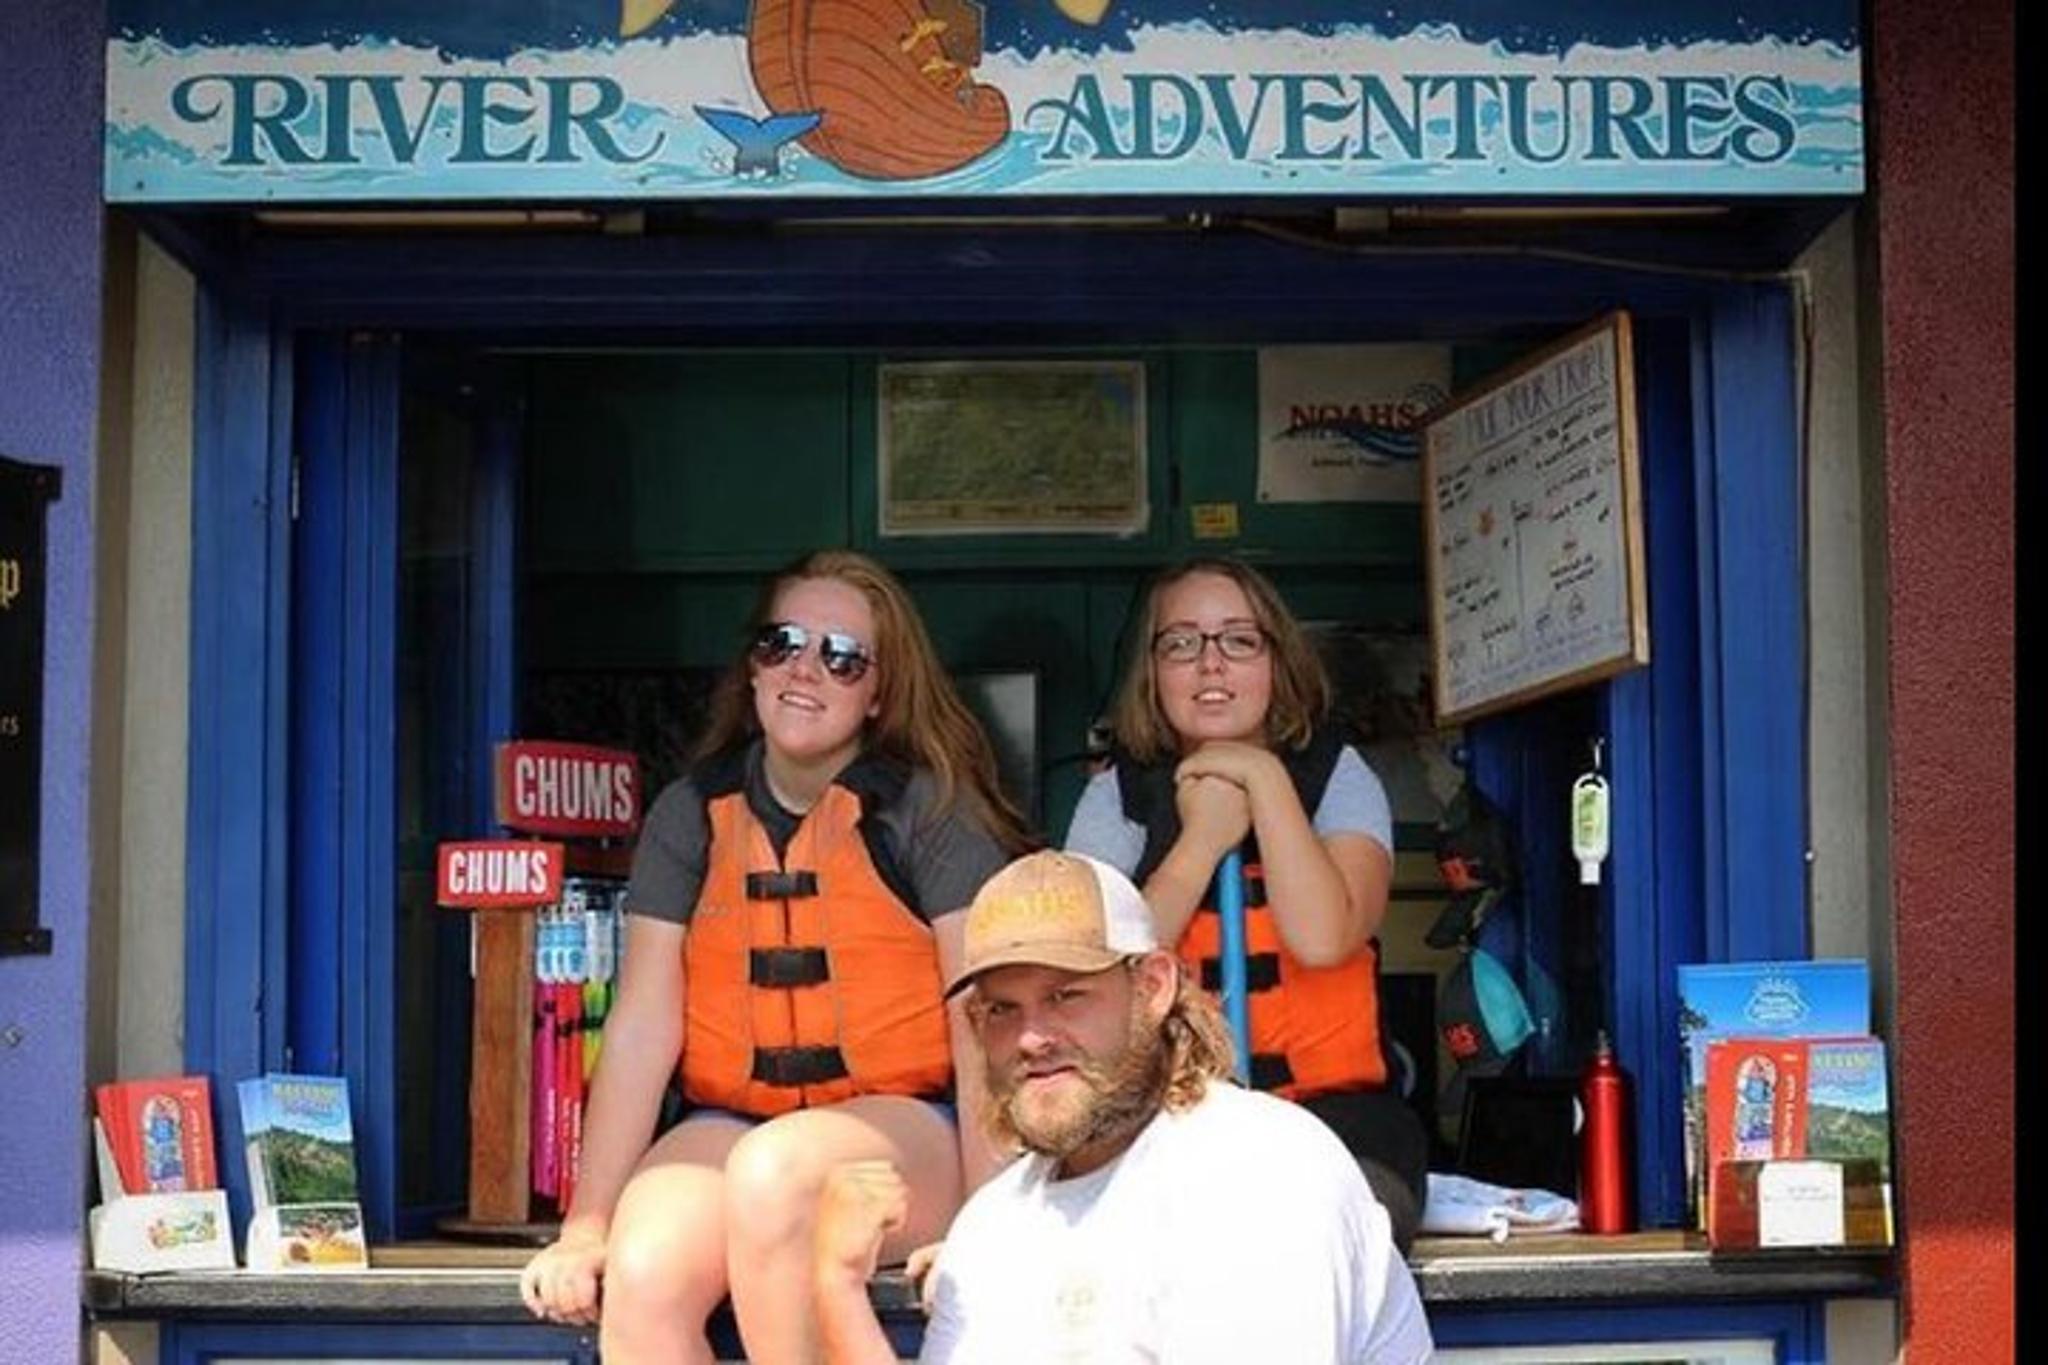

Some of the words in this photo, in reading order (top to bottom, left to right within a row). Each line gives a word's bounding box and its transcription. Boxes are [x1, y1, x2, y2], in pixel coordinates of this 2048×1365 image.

[172, 73, 667, 167] RIVER
[1025, 72, 1798, 164] ADVENTURES
[1288, 401, 1419, 431] NOAHS
[515, 753, 635, 823] CHUMS
[449, 850, 550, 895] CHUMS
